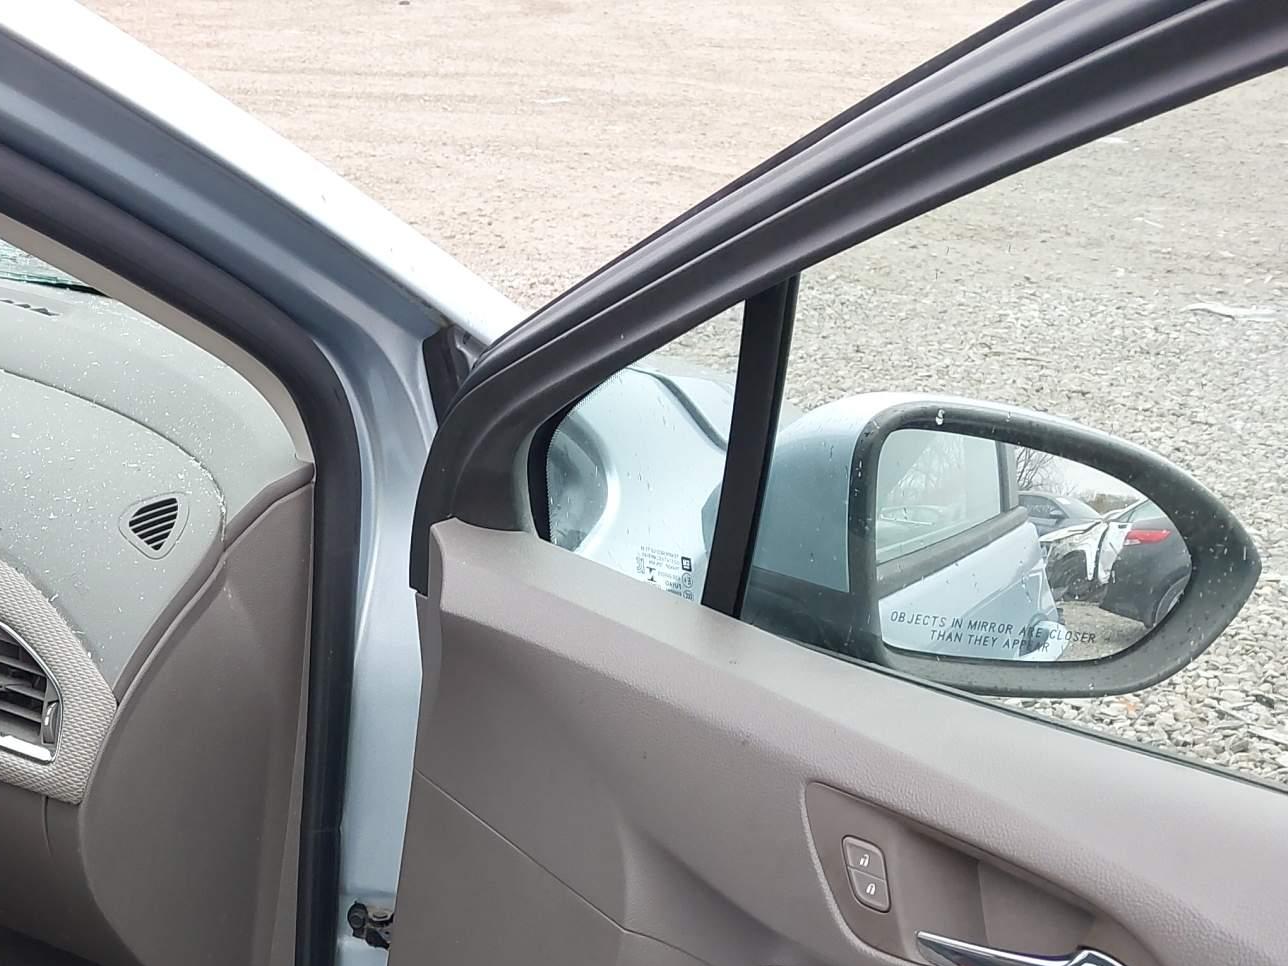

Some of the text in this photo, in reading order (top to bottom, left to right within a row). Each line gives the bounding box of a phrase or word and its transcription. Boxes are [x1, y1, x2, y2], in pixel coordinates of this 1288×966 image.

[890, 610, 1096, 643] OBJECTS IN MIRROR ARE CLOSER
[930, 630, 963, 642] THAN
[967, 635, 998, 648] THEY
